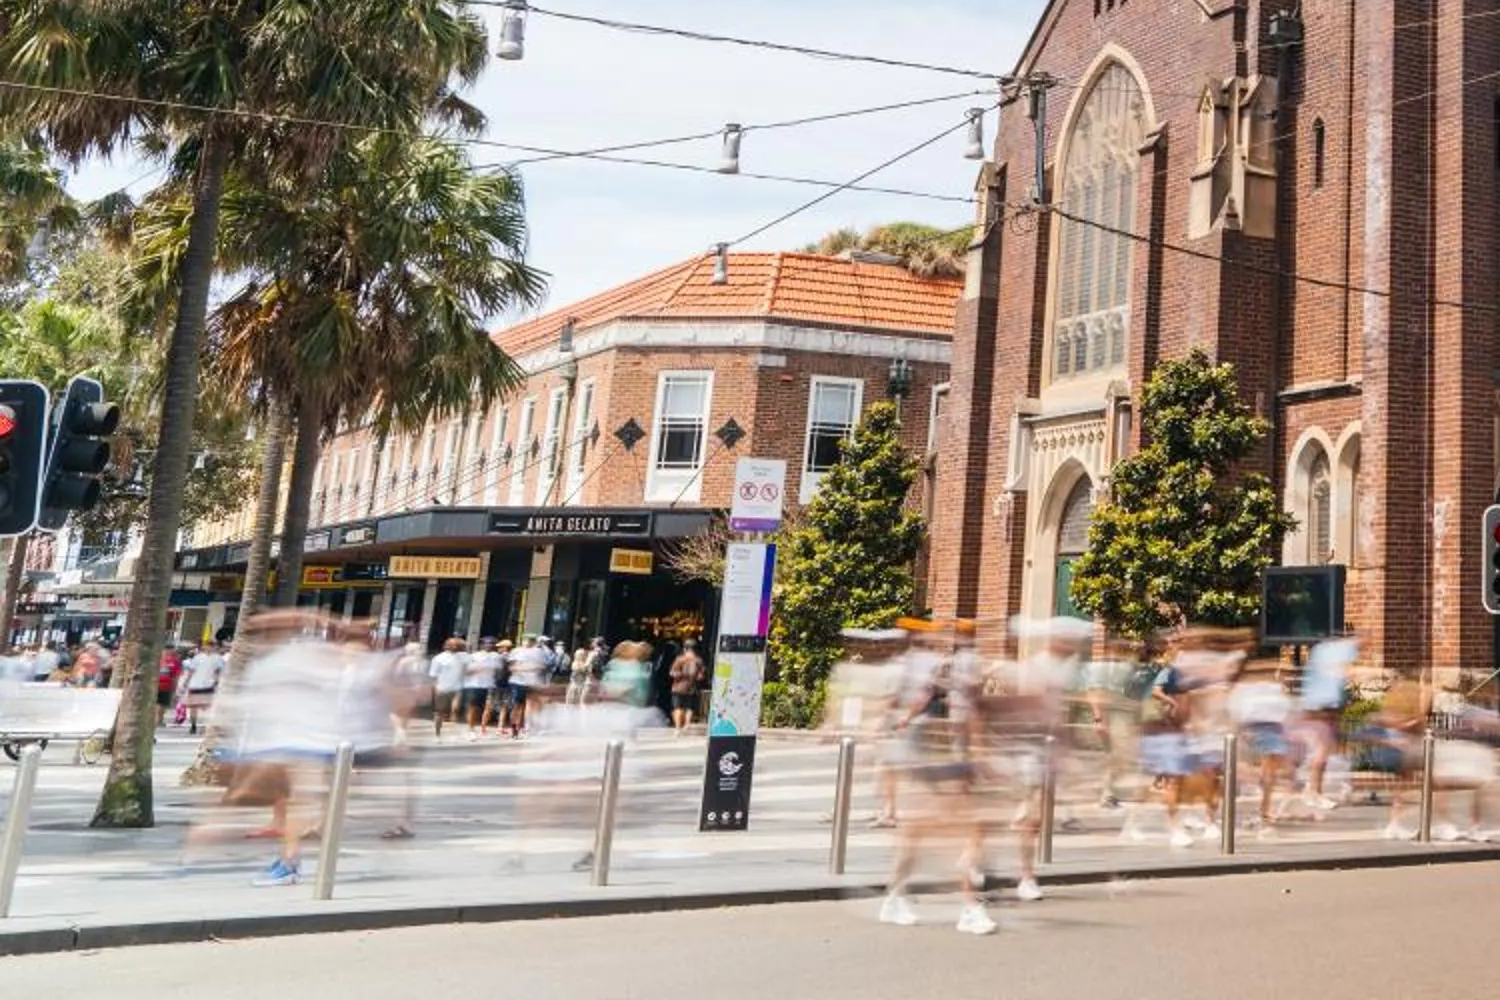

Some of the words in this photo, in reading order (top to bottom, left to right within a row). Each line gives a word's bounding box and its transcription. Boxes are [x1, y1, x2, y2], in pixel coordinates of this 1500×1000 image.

[527, 517, 562, 531] ANITA
[567, 517, 611, 531] GELATO
[394, 559, 429, 572] ANITA
[435, 560, 477, 573] GELATO
